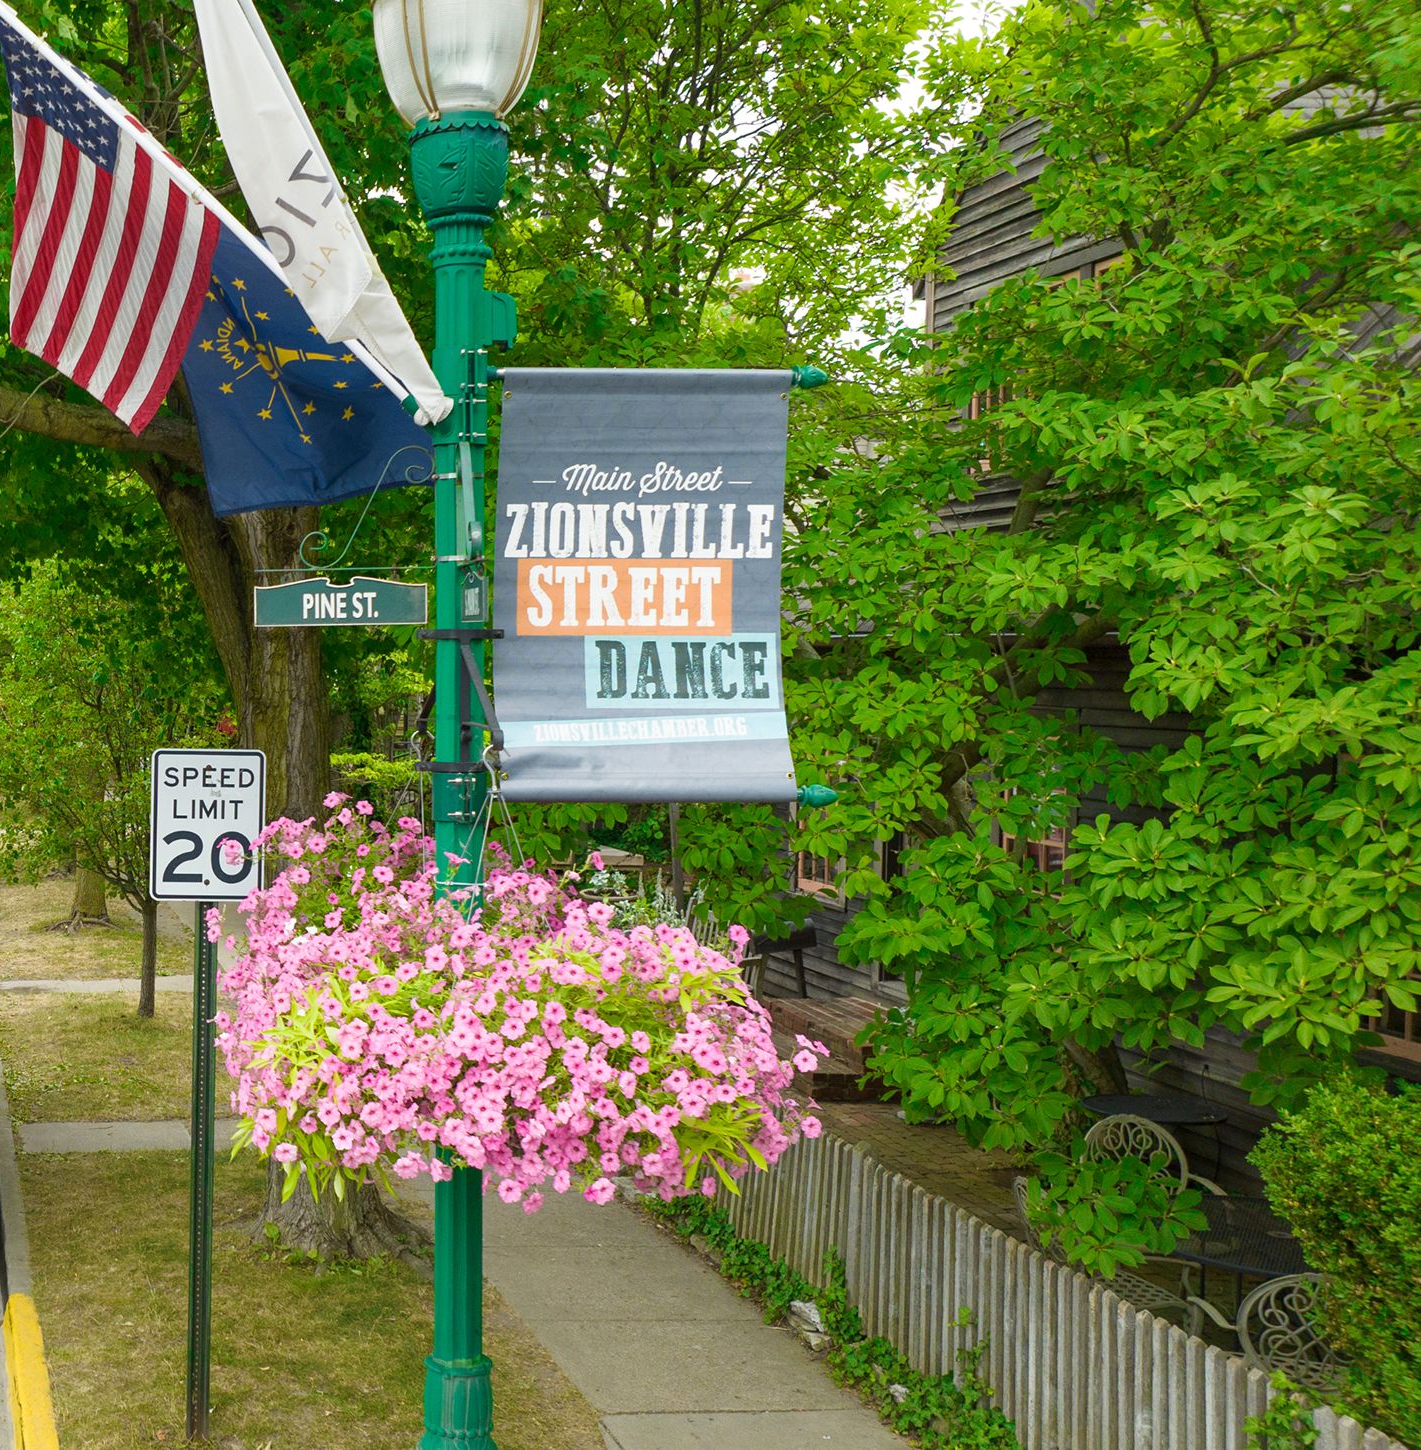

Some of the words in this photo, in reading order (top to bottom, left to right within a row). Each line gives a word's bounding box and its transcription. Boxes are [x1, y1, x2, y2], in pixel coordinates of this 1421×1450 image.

[562, 463, 635, 496] Main
[639, 461, 723, 498] Street
[504, 501, 775, 559] ZIONSVILLE
[303, 592, 347, 619] PINE
[352, 592, 379, 618] ST.
[526, 564, 721, 628] STREET
[595, 640, 770, 699] DANCE
[532, 717, 748, 742] ZIONSVILLECHAMBER.ORG
[163, 766, 255, 788] SPEED
[173, 799, 244, 820] LIMIT
[162, 830, 254, 885] 20
